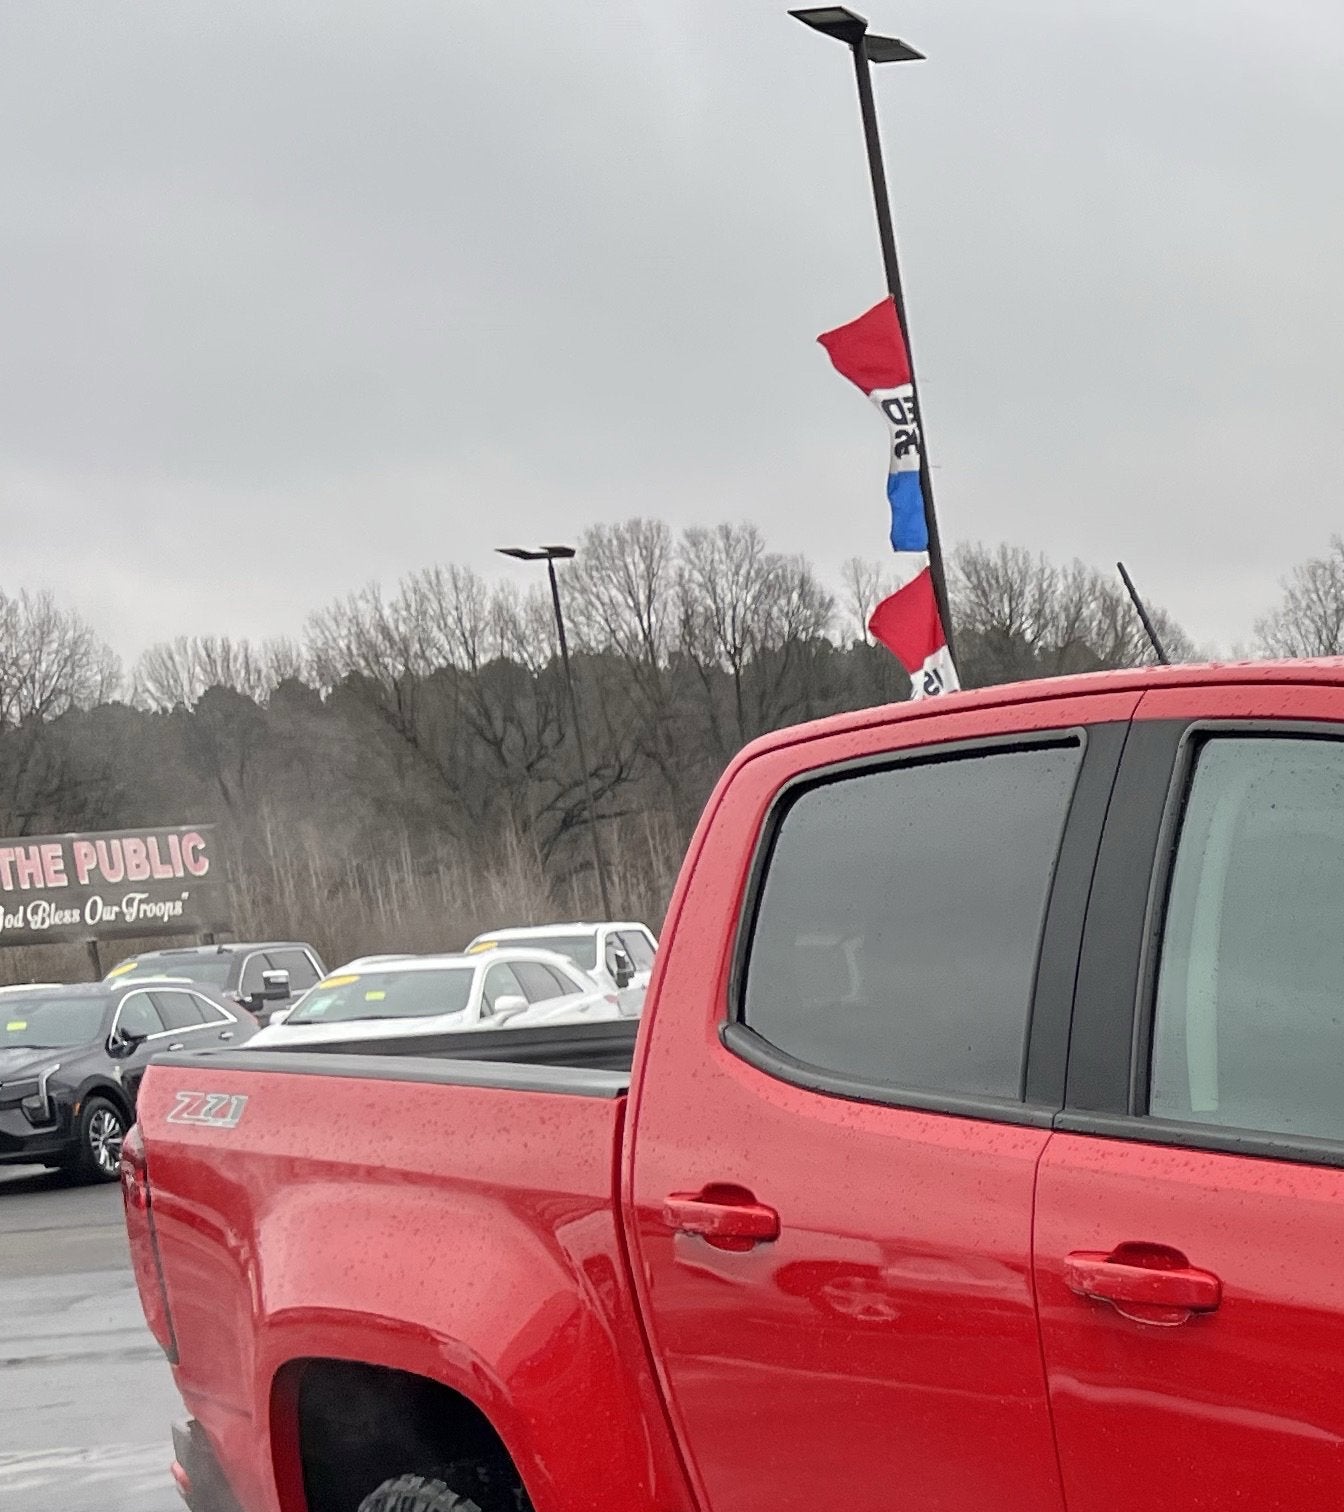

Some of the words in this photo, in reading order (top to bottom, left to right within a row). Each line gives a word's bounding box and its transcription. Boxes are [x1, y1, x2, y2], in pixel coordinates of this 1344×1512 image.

[0, 843, 69, 891] THE
[73, 831, 210, 885] PUBLIC
[27, 899, 81, 930] Bless
[84, 895, 121, 926] Our
[166, 1091, 249, 1129] Z71
